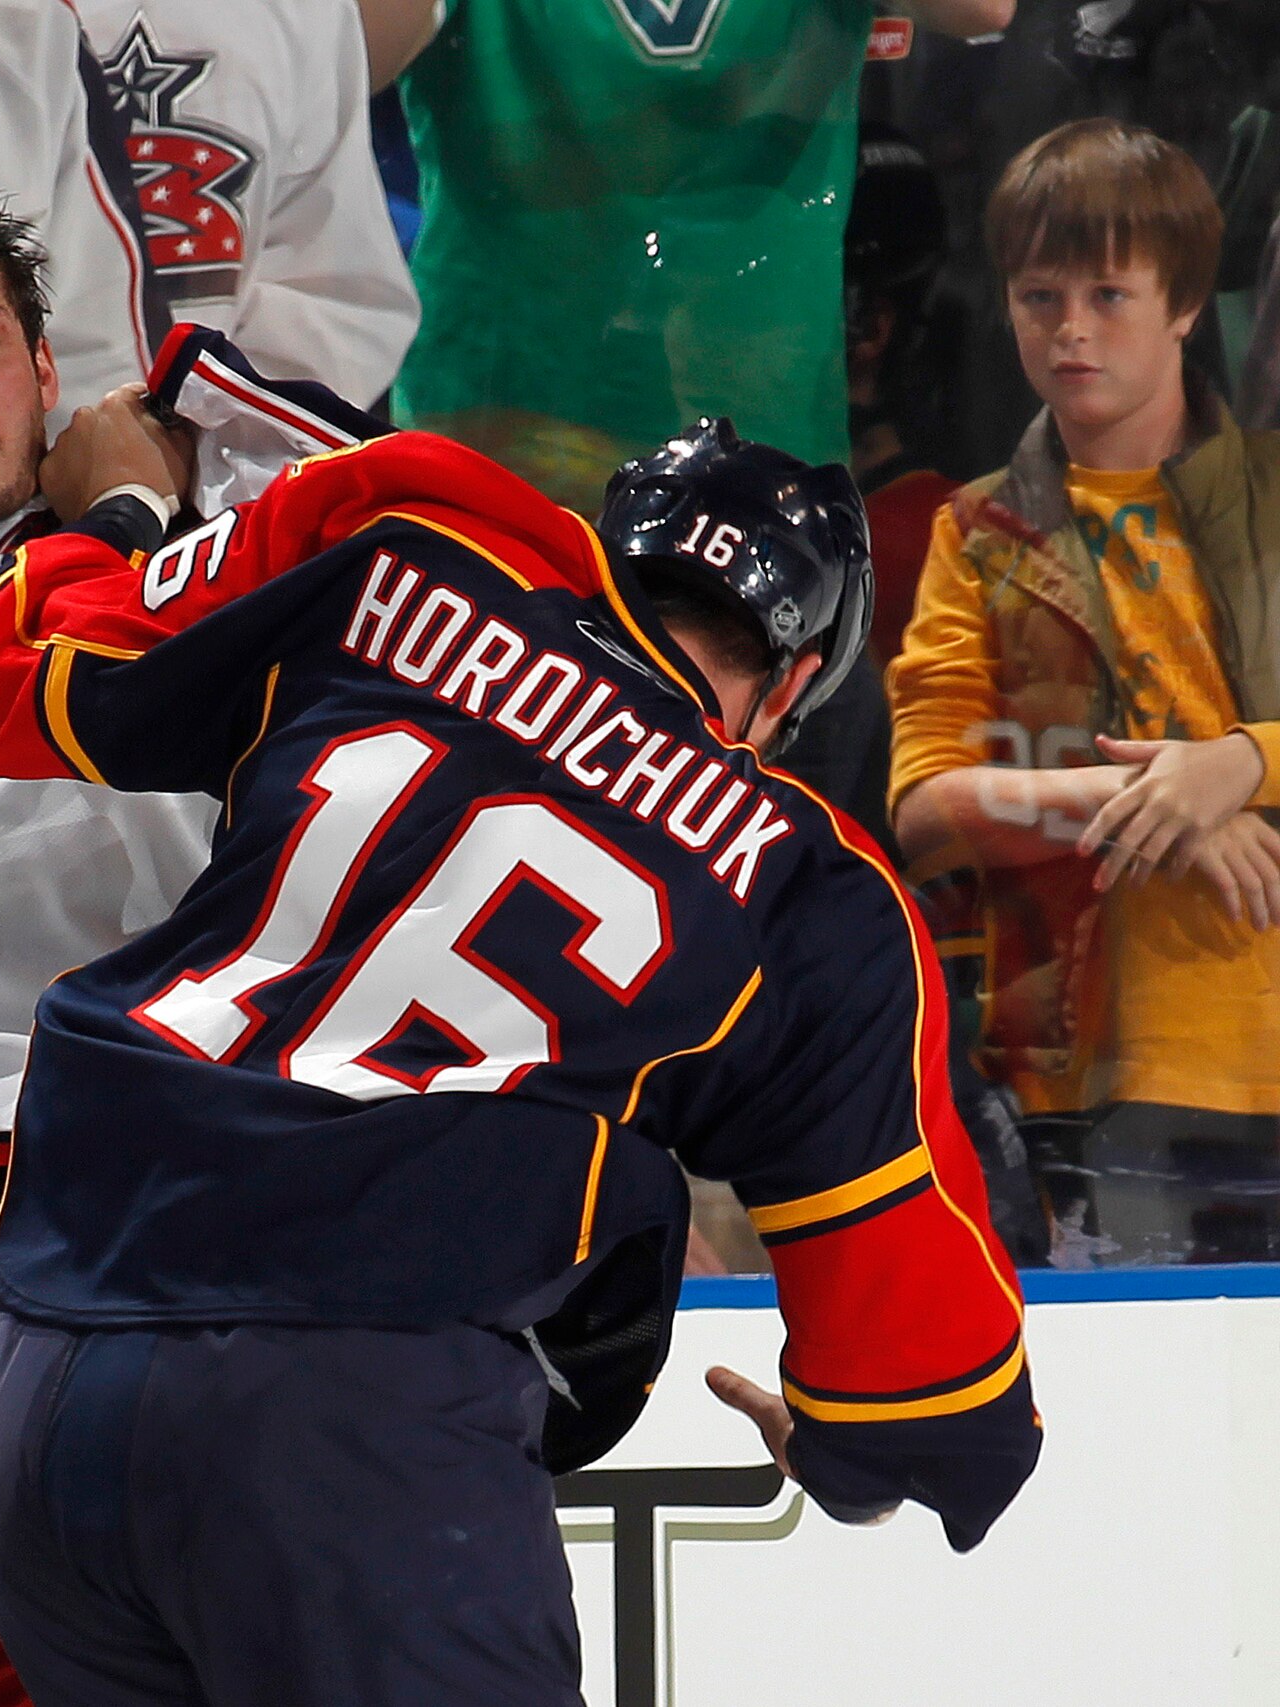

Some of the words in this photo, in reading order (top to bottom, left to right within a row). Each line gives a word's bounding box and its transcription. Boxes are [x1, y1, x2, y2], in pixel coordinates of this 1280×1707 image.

[679, 513, 743, 568] 16
[339, 547, 793, 906] HORDICHUK
[128, 720, 676, 1101] 16
